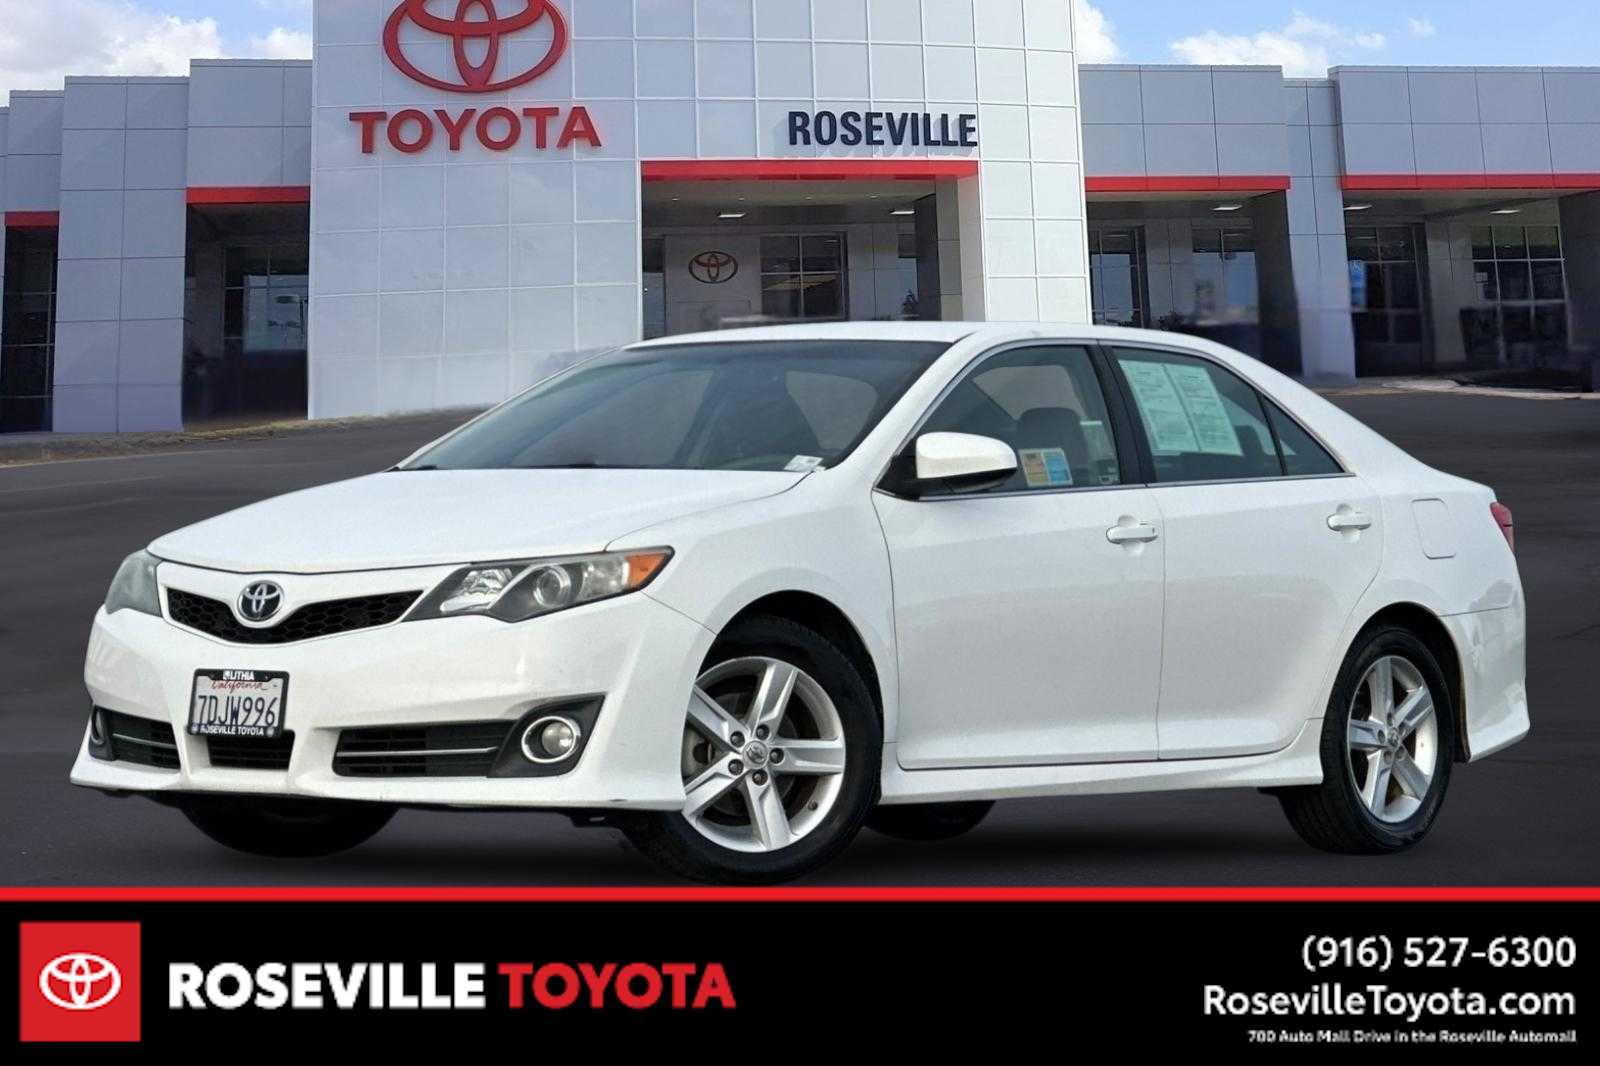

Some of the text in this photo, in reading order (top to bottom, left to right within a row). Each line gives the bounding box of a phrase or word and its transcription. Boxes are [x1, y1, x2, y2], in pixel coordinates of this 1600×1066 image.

[350, 107, 603, 154] TOYOTA
[789, 111, 977, 147] ROSEVILLE
[212, 681, 264, 693] California
[230, 671, 255, 681] LITHIA
[198, 695, 277, 728] 7DJW996
[200, 724, 264, 736] ROSEVILLE TOYOTA
